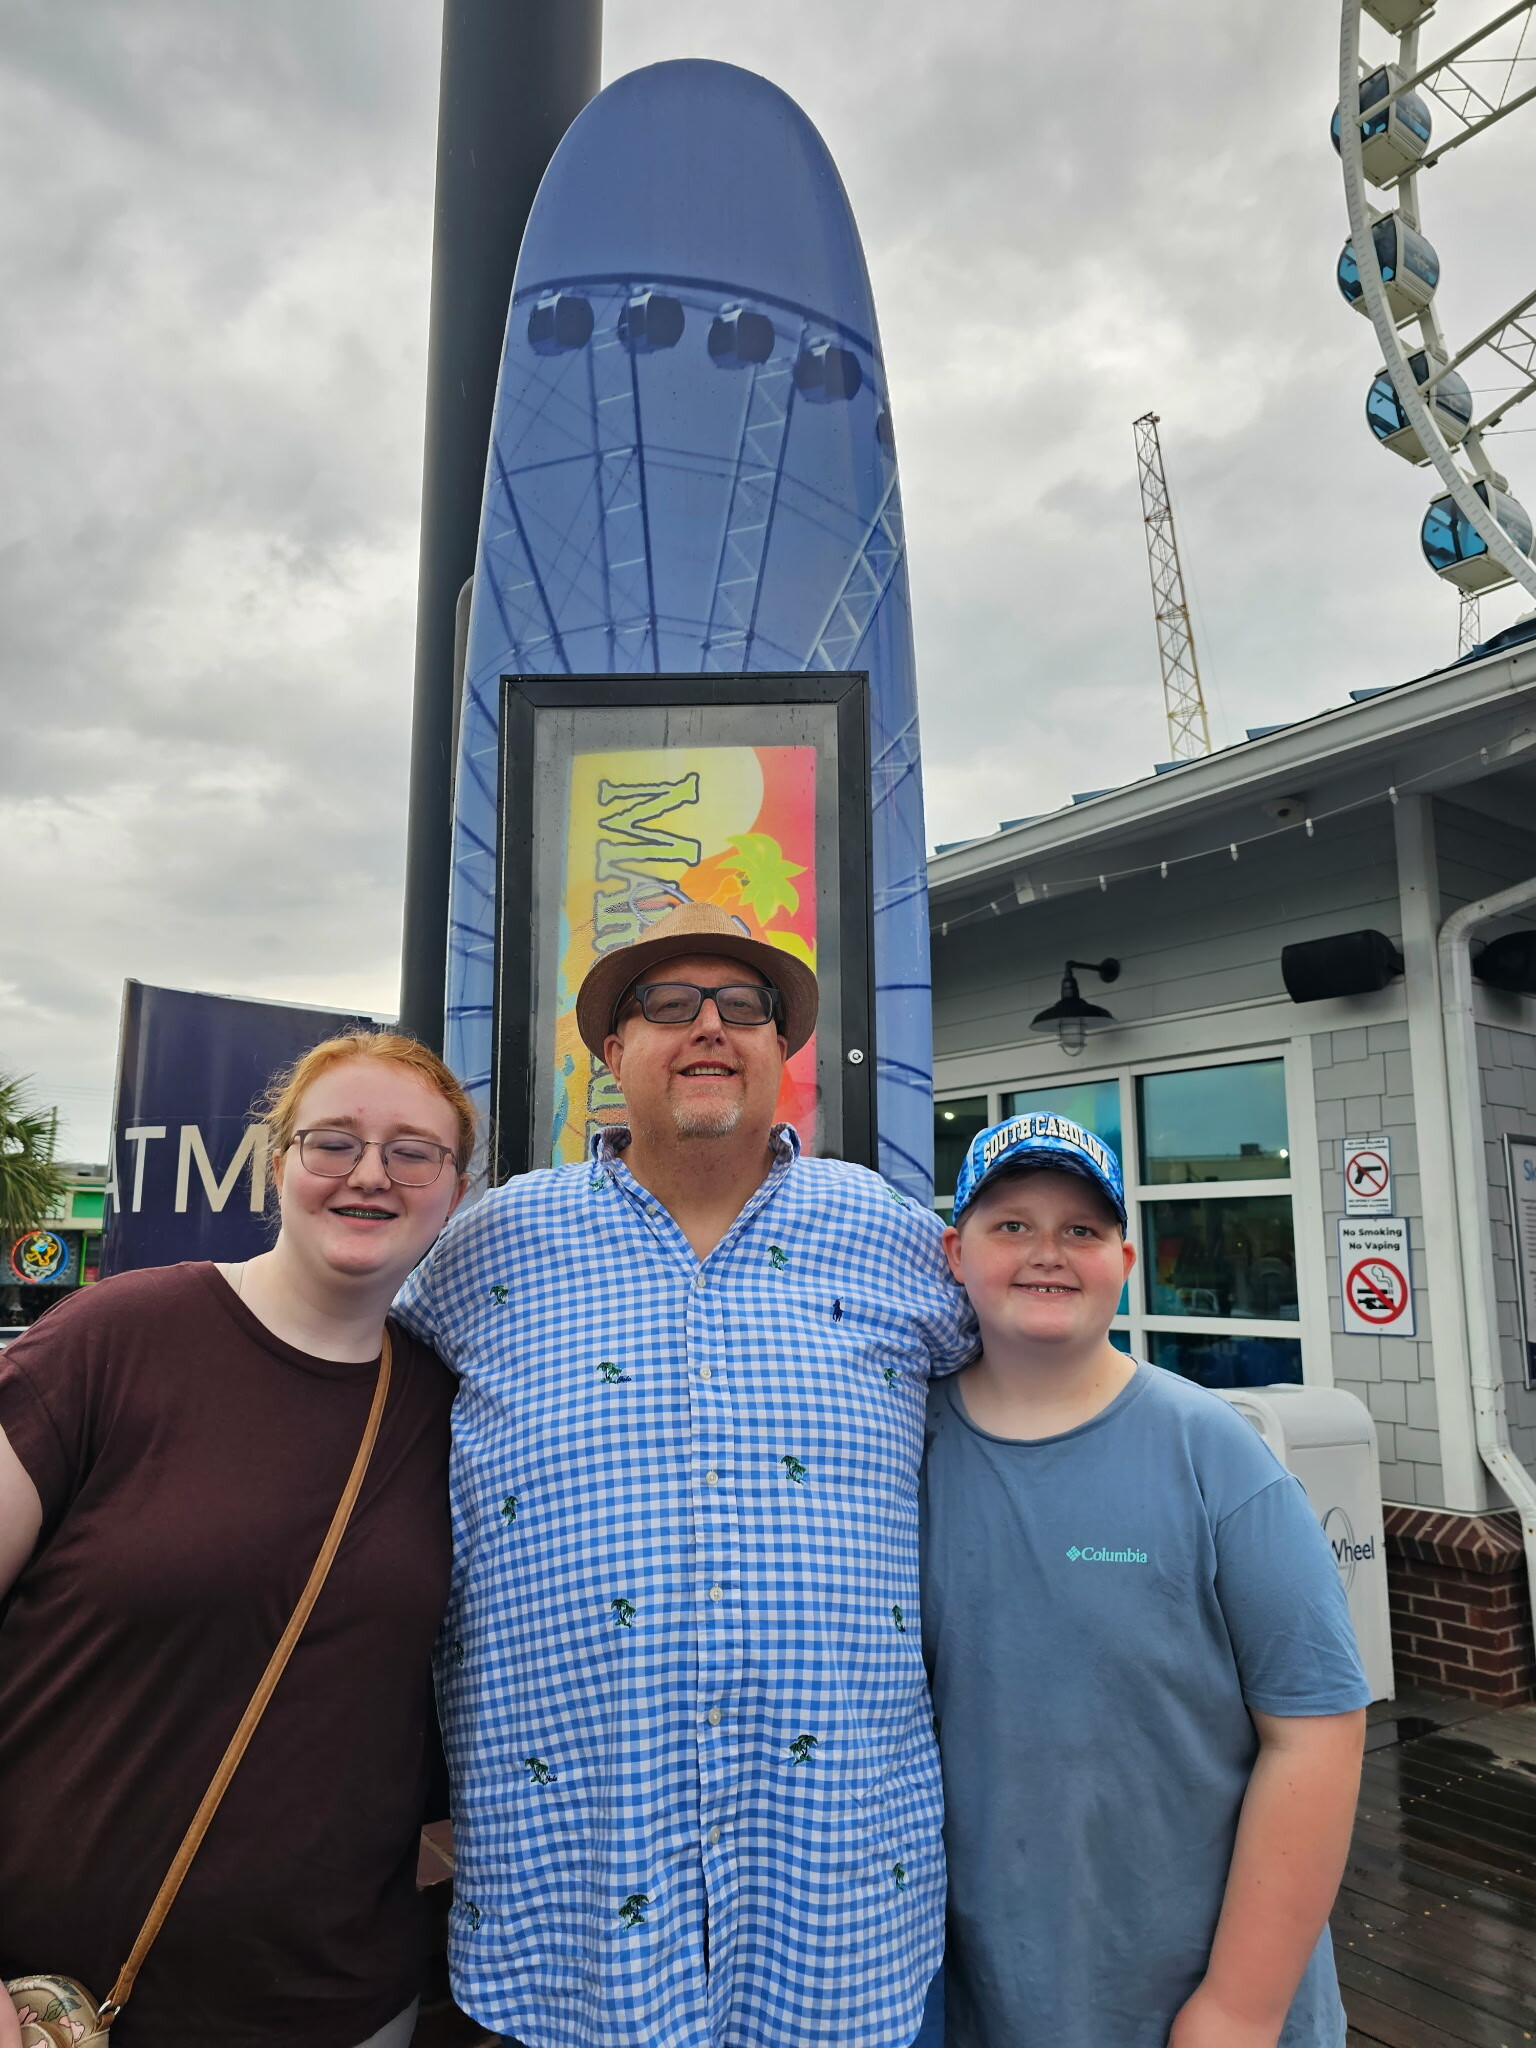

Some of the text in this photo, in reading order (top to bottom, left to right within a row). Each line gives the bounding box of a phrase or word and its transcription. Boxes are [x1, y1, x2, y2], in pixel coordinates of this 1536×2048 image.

[983, 1115, 1110, 1180] SOUTH CAROLINA
[1343, 1227, 1403, 1237] No Smoking
[1349, 1241, 1400, 1251] No Vaping
[1081, 1546, 1148, 1564] Columbia
